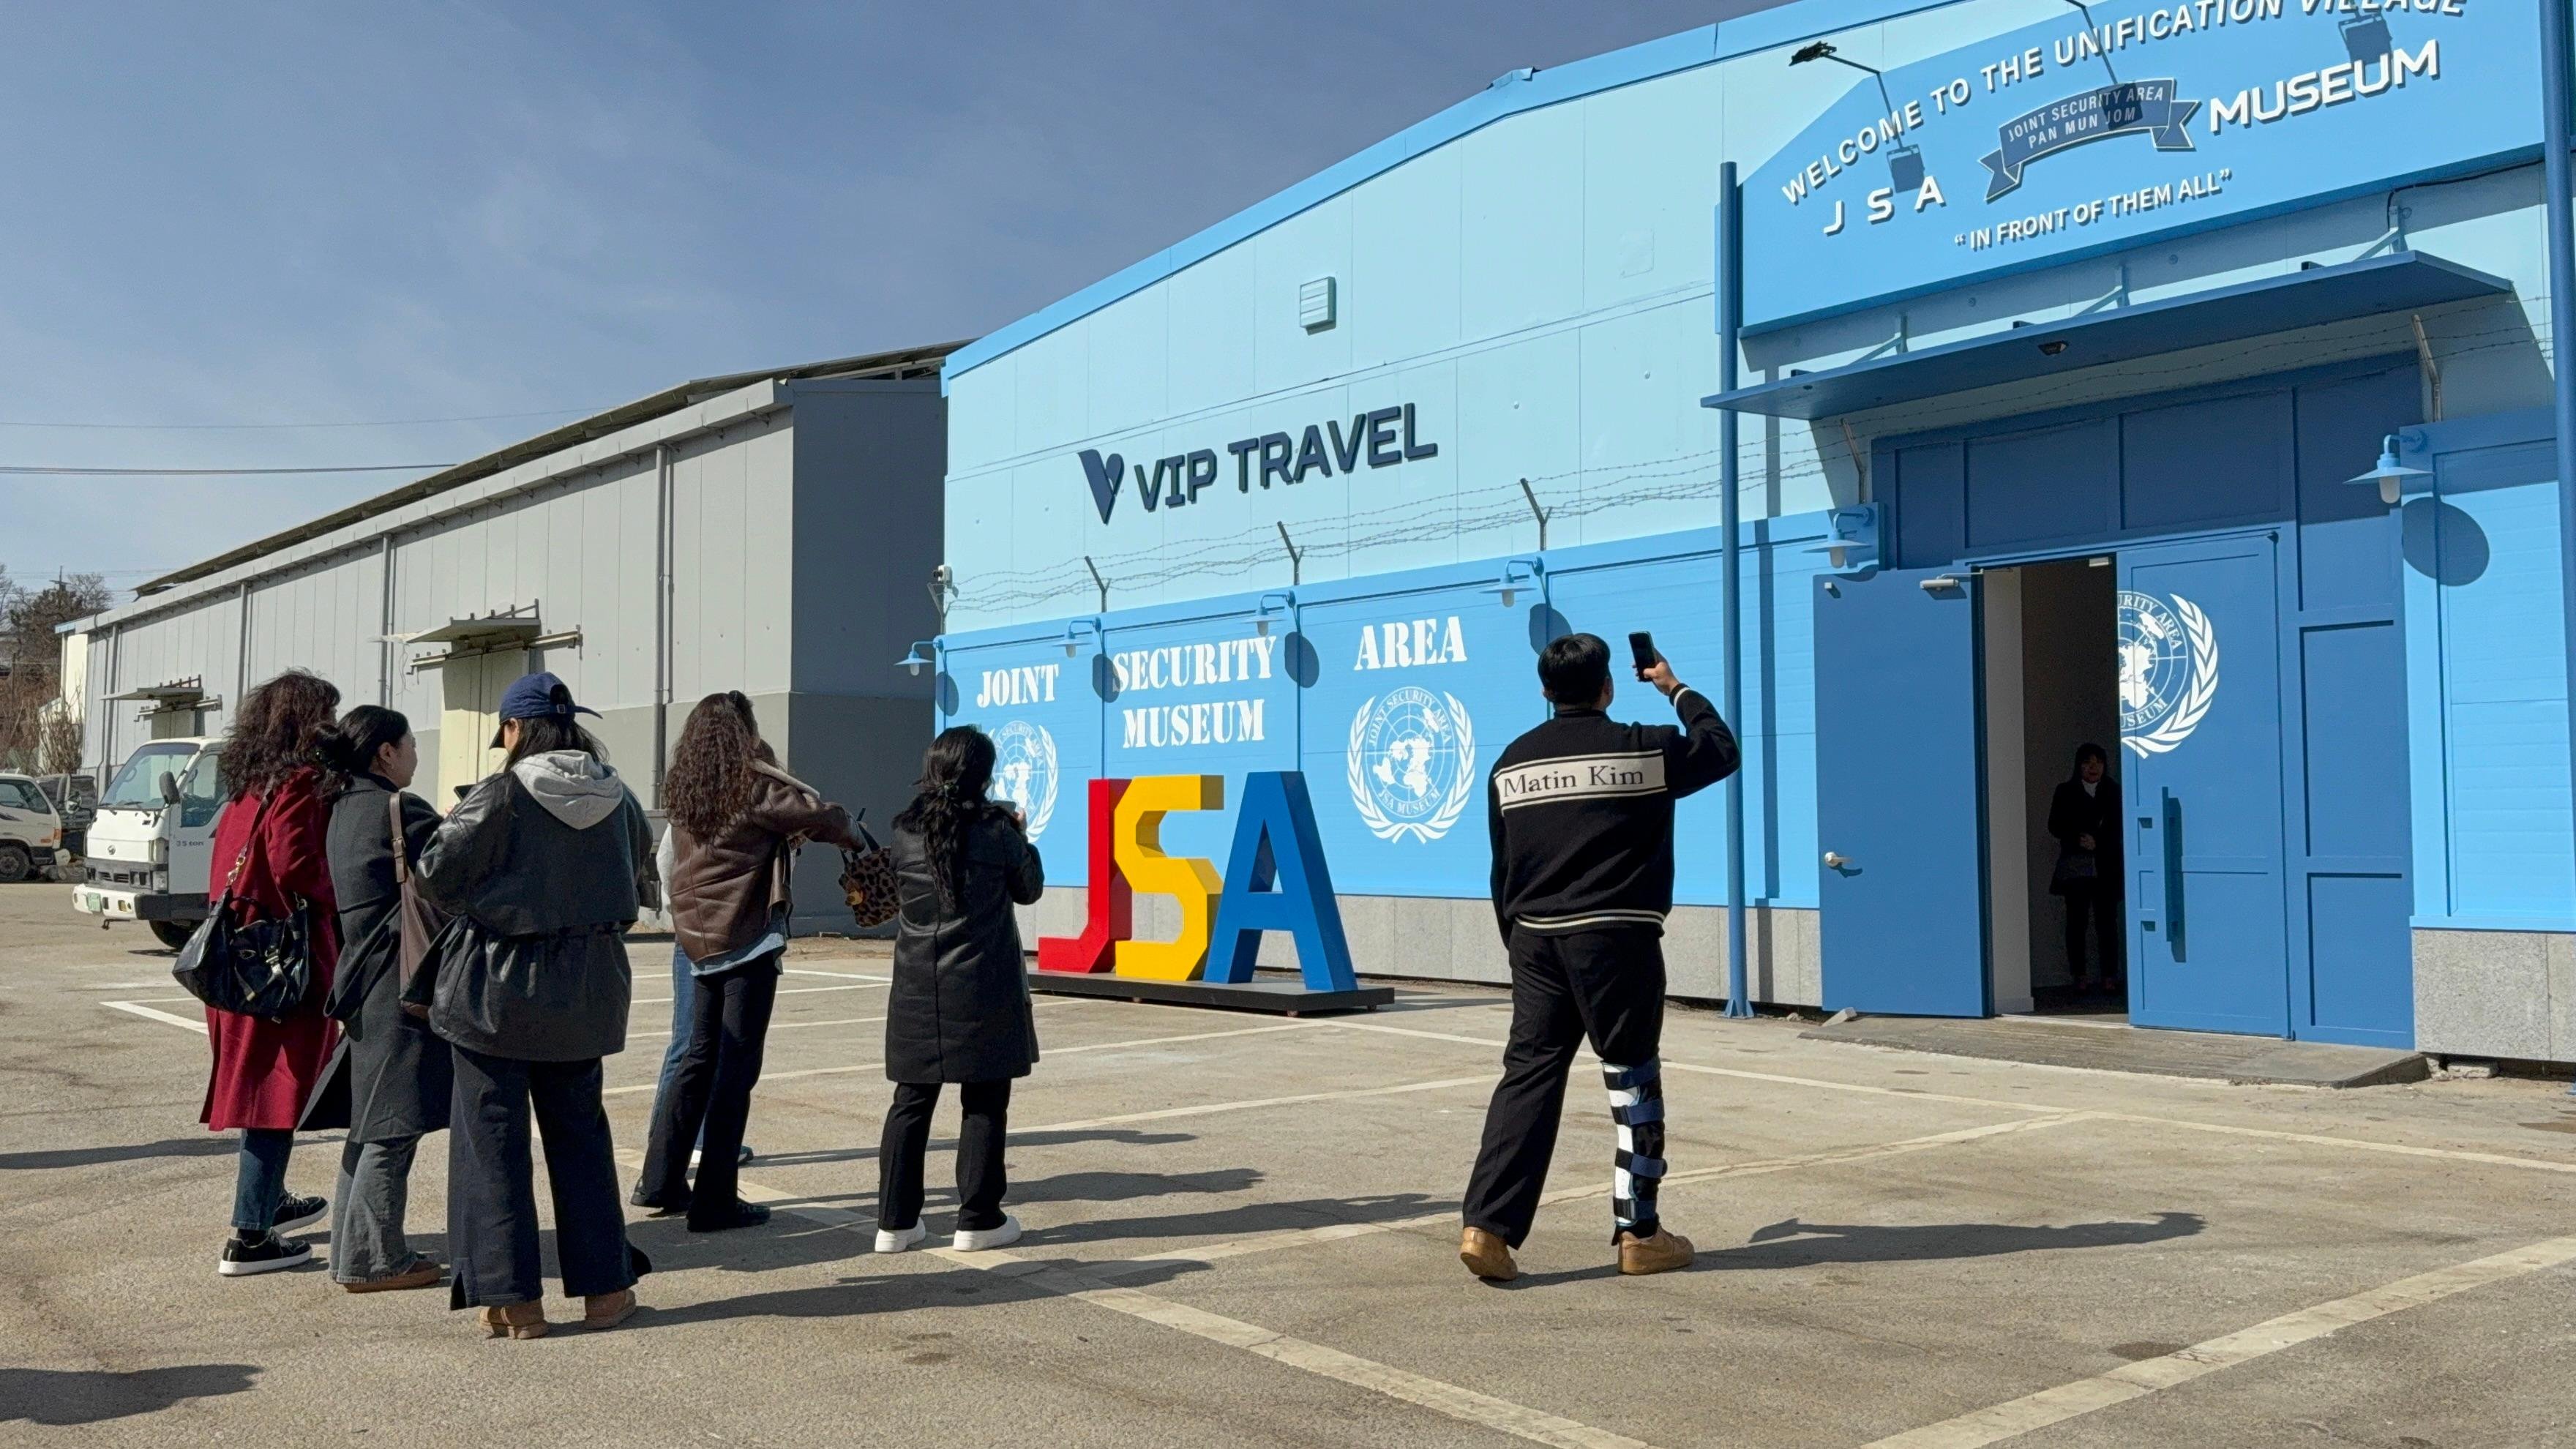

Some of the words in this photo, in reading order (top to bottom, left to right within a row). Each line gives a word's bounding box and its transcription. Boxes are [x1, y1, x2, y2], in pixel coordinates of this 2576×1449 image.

[1781, 100, 1923, 203] WELCOME
[1930, 78, 1969, 113] TO
[1980, 47, 2043, 91] THE
[2055, 0, 2282, 64] UNIFICATION
[2008, 113, 2046, 142] JOINT
[2051, 90, 2121, 121] SECURITY
[2126, 86, 2164, 102] AREA
[2210, 39, 2439, 134] MUSEUM
[2029, 127, 2057, 149] PAN
[2065, 114, 2097, 135] MUN
[2105, 107, 2135, 124] JOM
[1997, 208, 2070, 244] FRONT
[2073, 200, 2105, 225] OF
[2108, 183, 2173, 216] THEM
[1134, 448, 1218, 512] VIP
[1227, 402, 1438, 493] TRAVEL
[2155, 613, 2182, 651] AREA
[976, 664, 1060, 708] JOINT
[1112, 635, 1276, 692] SECURITY
[1354, 615, 1468, 671] AREA
[1123, 699, 1265, 749] MUSEUM
[1368, 705, 1385, 746] JOINT
[1387, 689, 1435, 709] SECURITY
[1434, 709, 1451, 744] AREA
[1378, 789, 1394, 809] JSA
[1397, 787, 1440, 814] MUSEUM
[1503, 771, 1577, 798] Matin
[1588, 765, 1644, 787] Kim
[1038, 771, 1358, 992] JSA
